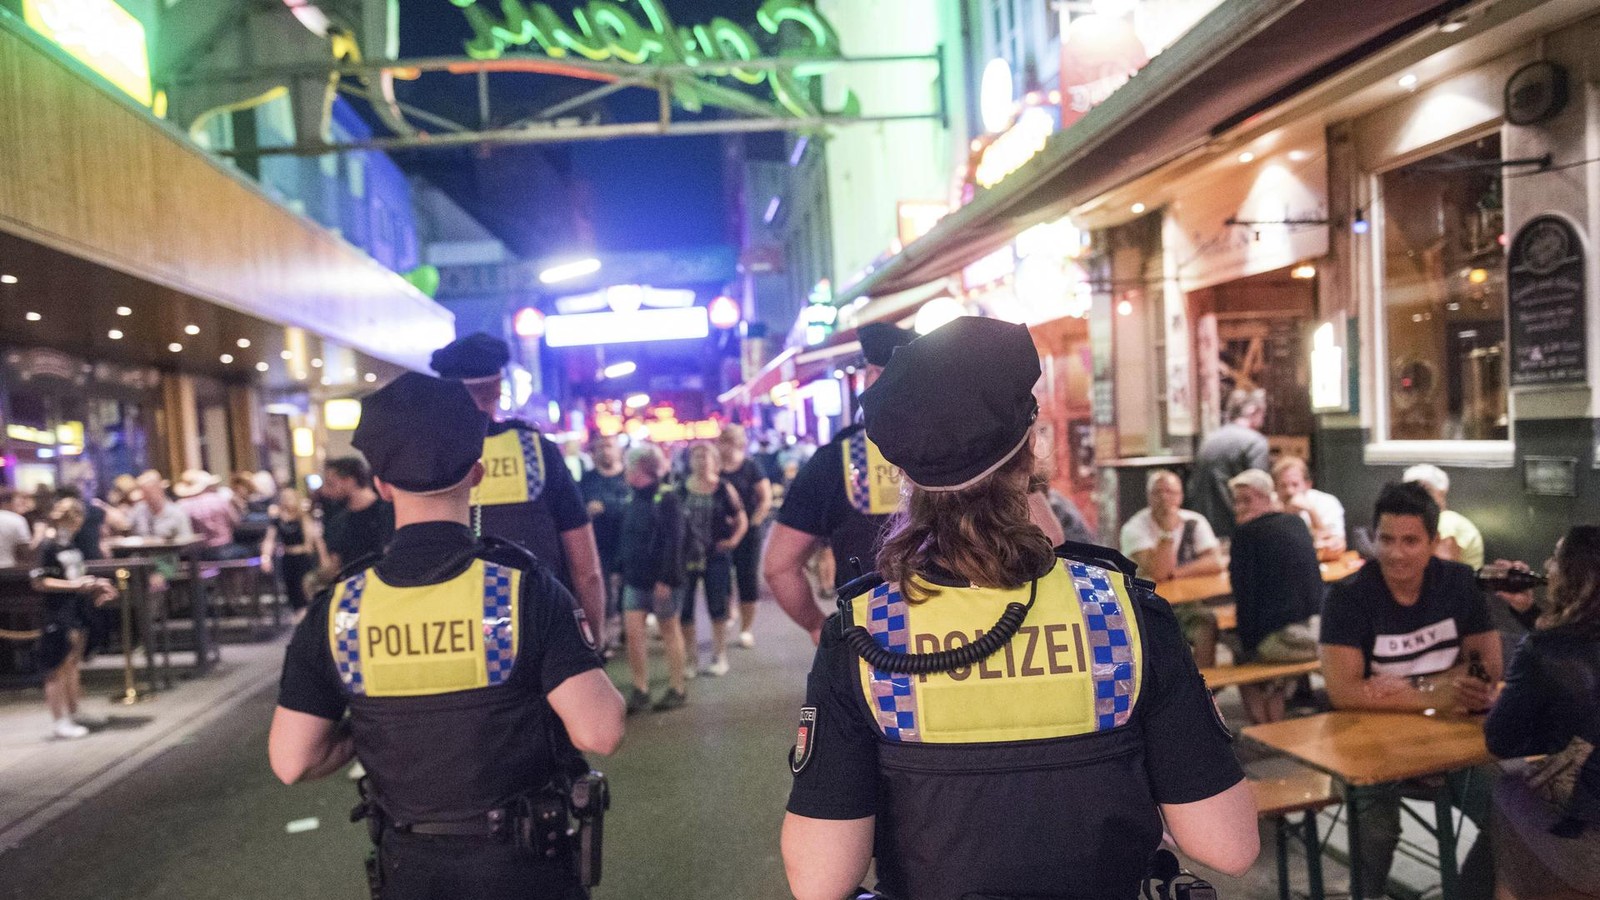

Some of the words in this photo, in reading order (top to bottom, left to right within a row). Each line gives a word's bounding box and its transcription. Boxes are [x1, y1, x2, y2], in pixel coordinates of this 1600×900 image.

[484, 456, 519, 478] IZEI
[366, 619, 475, 659] POLIZEI
[915, 623, 1087, 683] POLIZEI
[1389, 629, 1437, 652] DKNY
